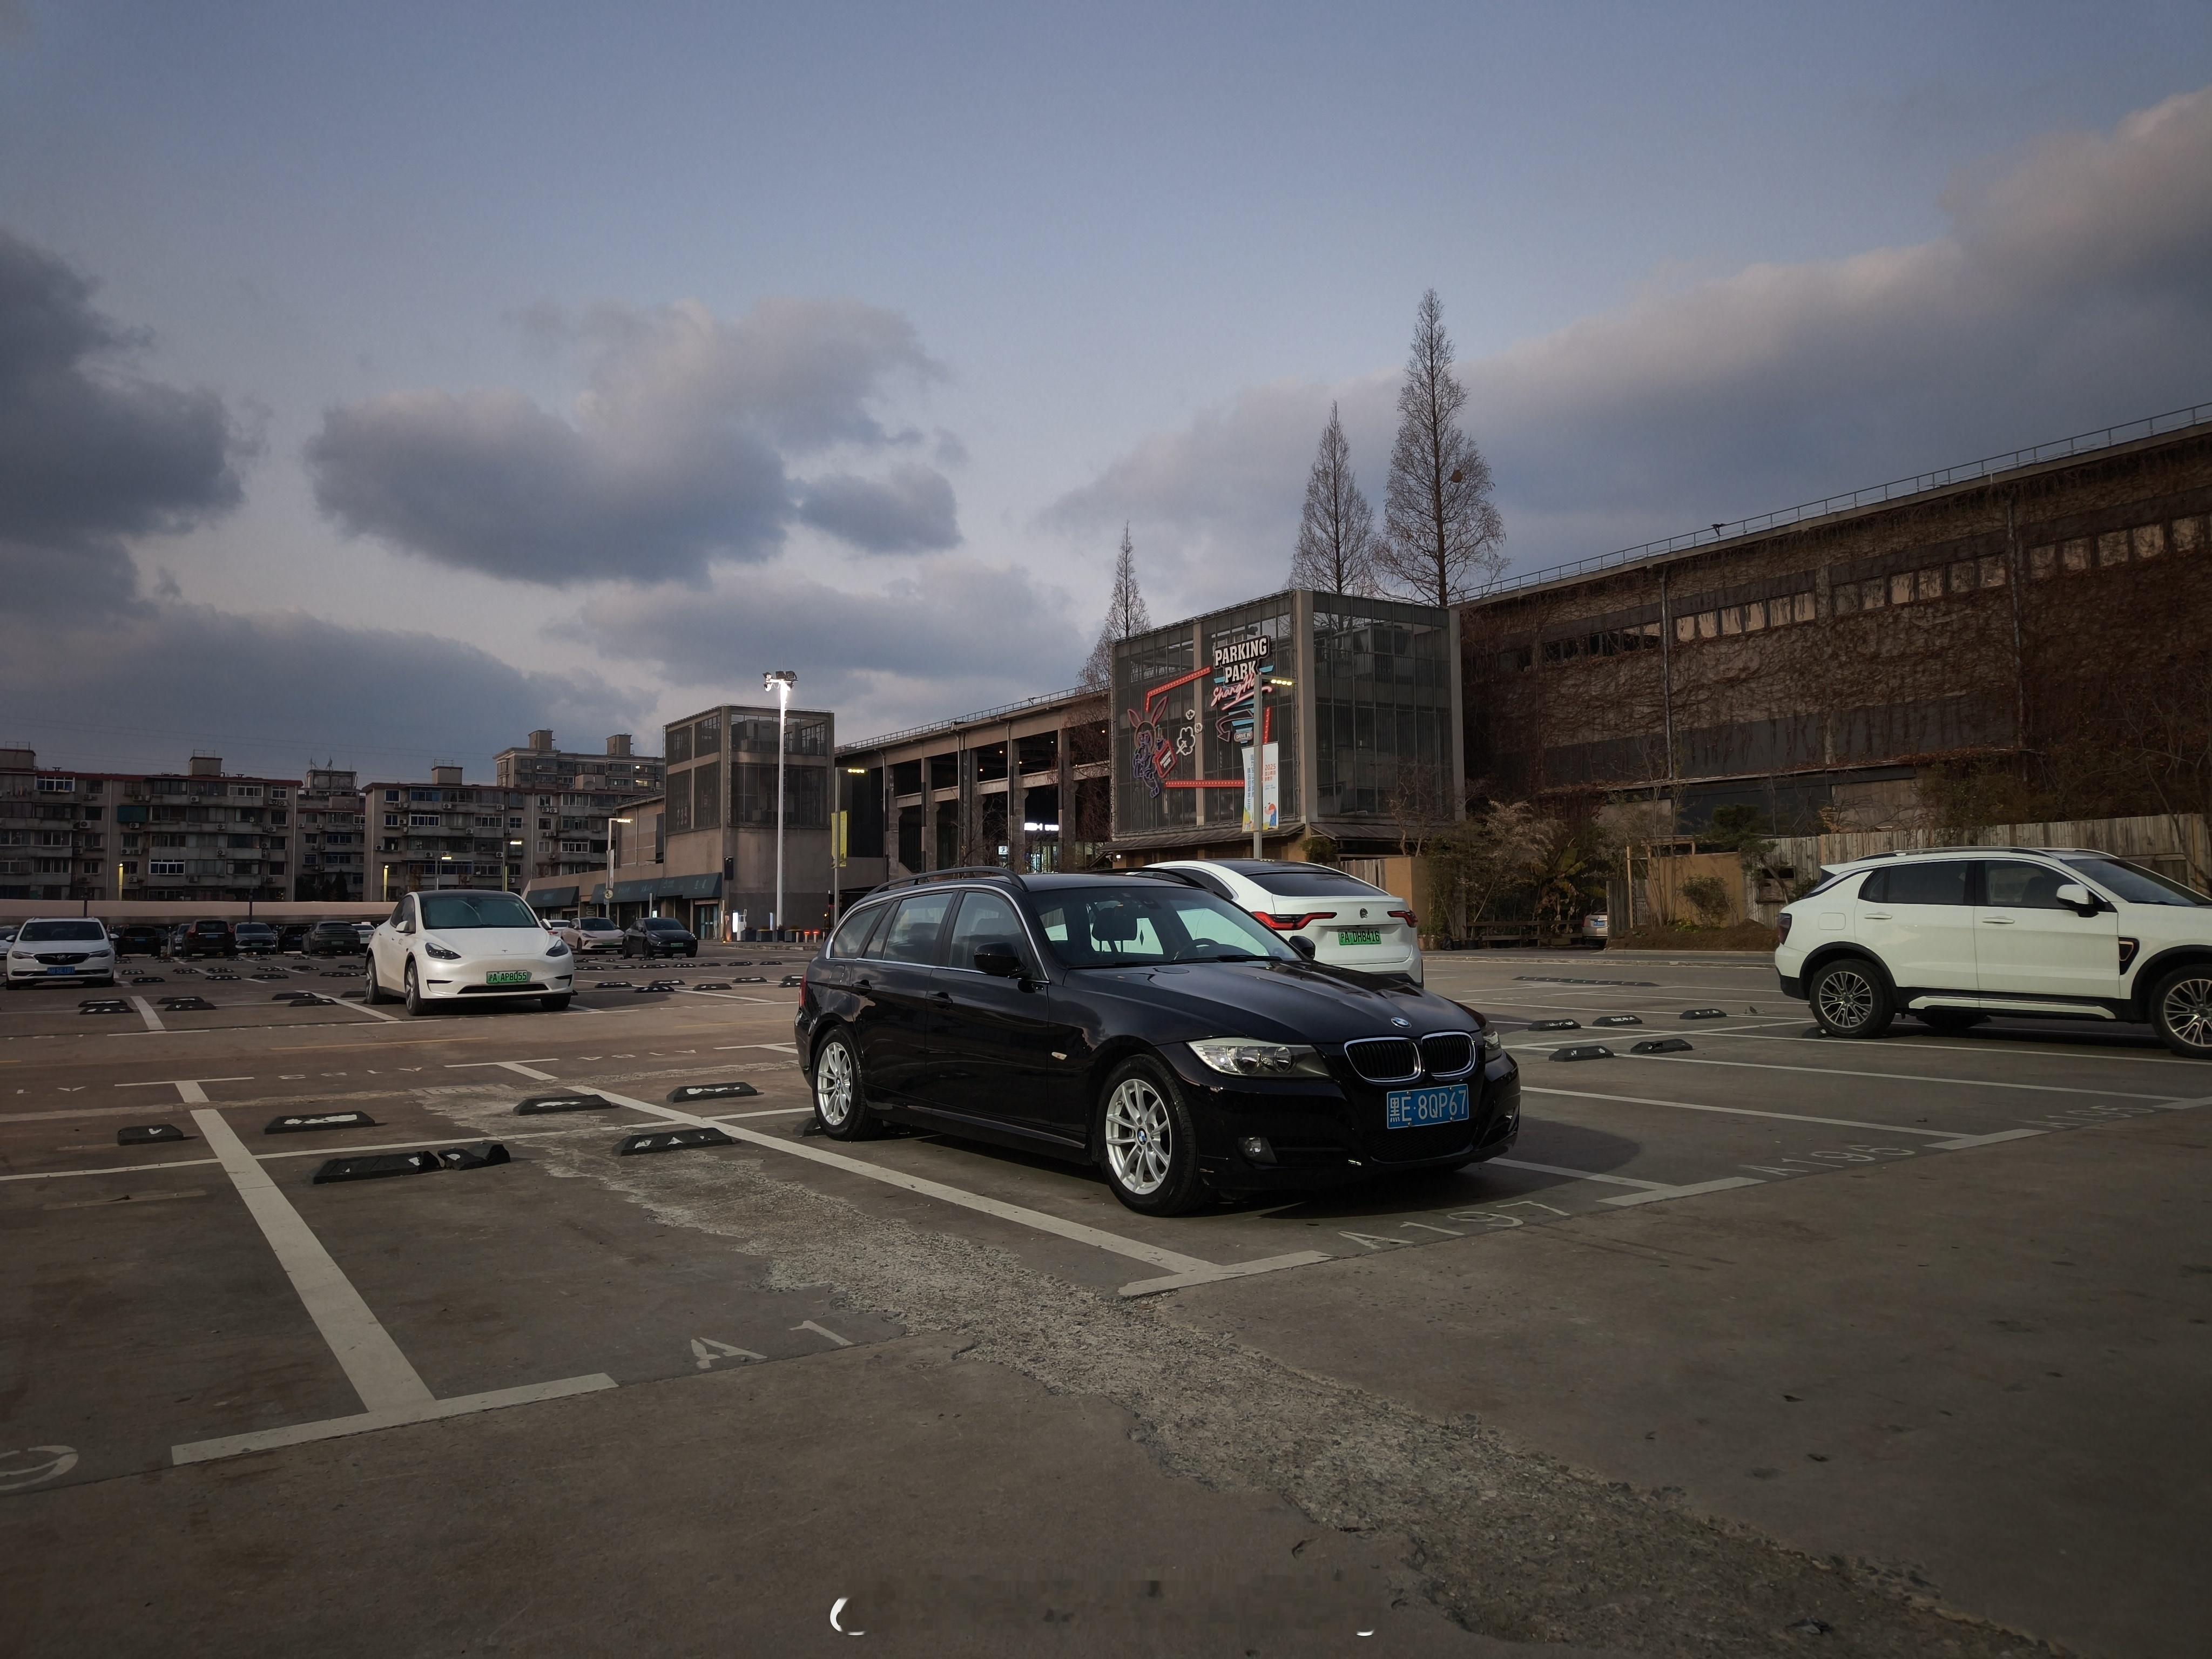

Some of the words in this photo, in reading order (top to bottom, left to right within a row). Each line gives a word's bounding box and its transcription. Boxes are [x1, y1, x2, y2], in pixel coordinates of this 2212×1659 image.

[1215, 638, 1267, 666] PARKING
[1225, 660, 1256, 683] PARK
[1211, 672, 1262, 707] ShangHa
[2012, 1105, 2156, 1129] A195
[1737, 1145, 1916, 1176] A196
[1337, 1201, 1571, 1250] A197
